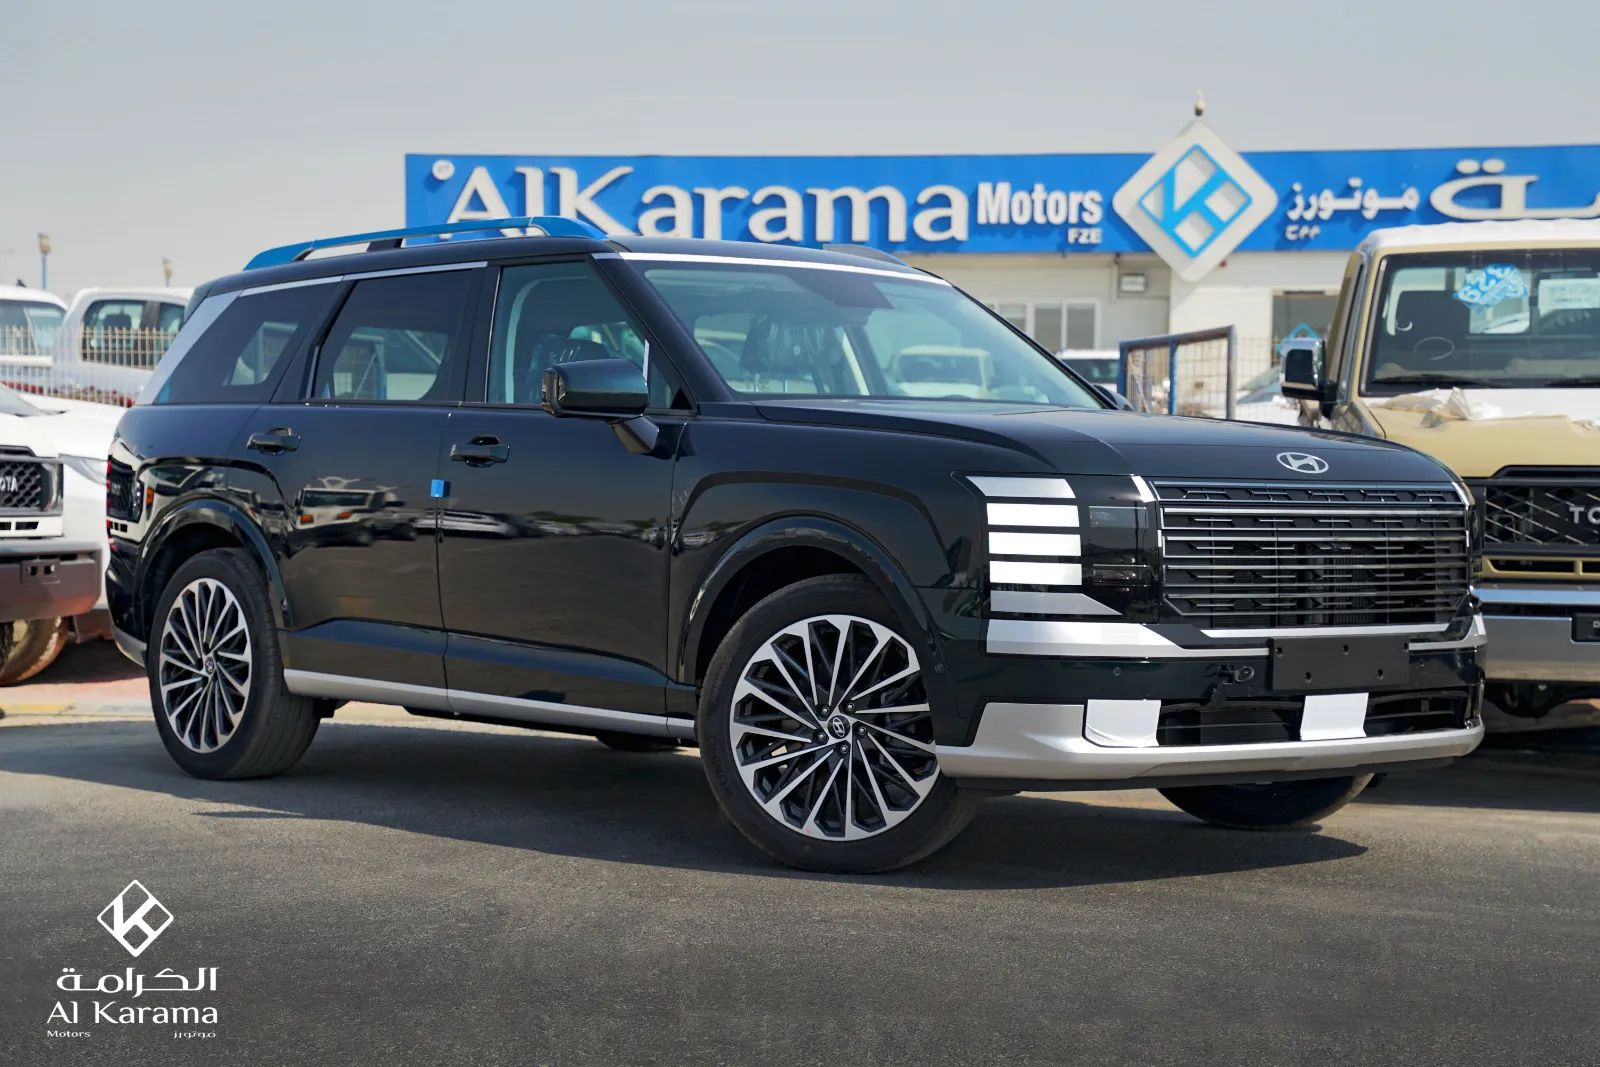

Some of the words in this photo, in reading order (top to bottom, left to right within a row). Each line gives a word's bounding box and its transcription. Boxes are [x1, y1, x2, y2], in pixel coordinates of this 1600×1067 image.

[977, 181, 1103, 225] Motors
[1286, 176, 1420, 220] موتورز
[1067, 227, 1102, 244] FZE
